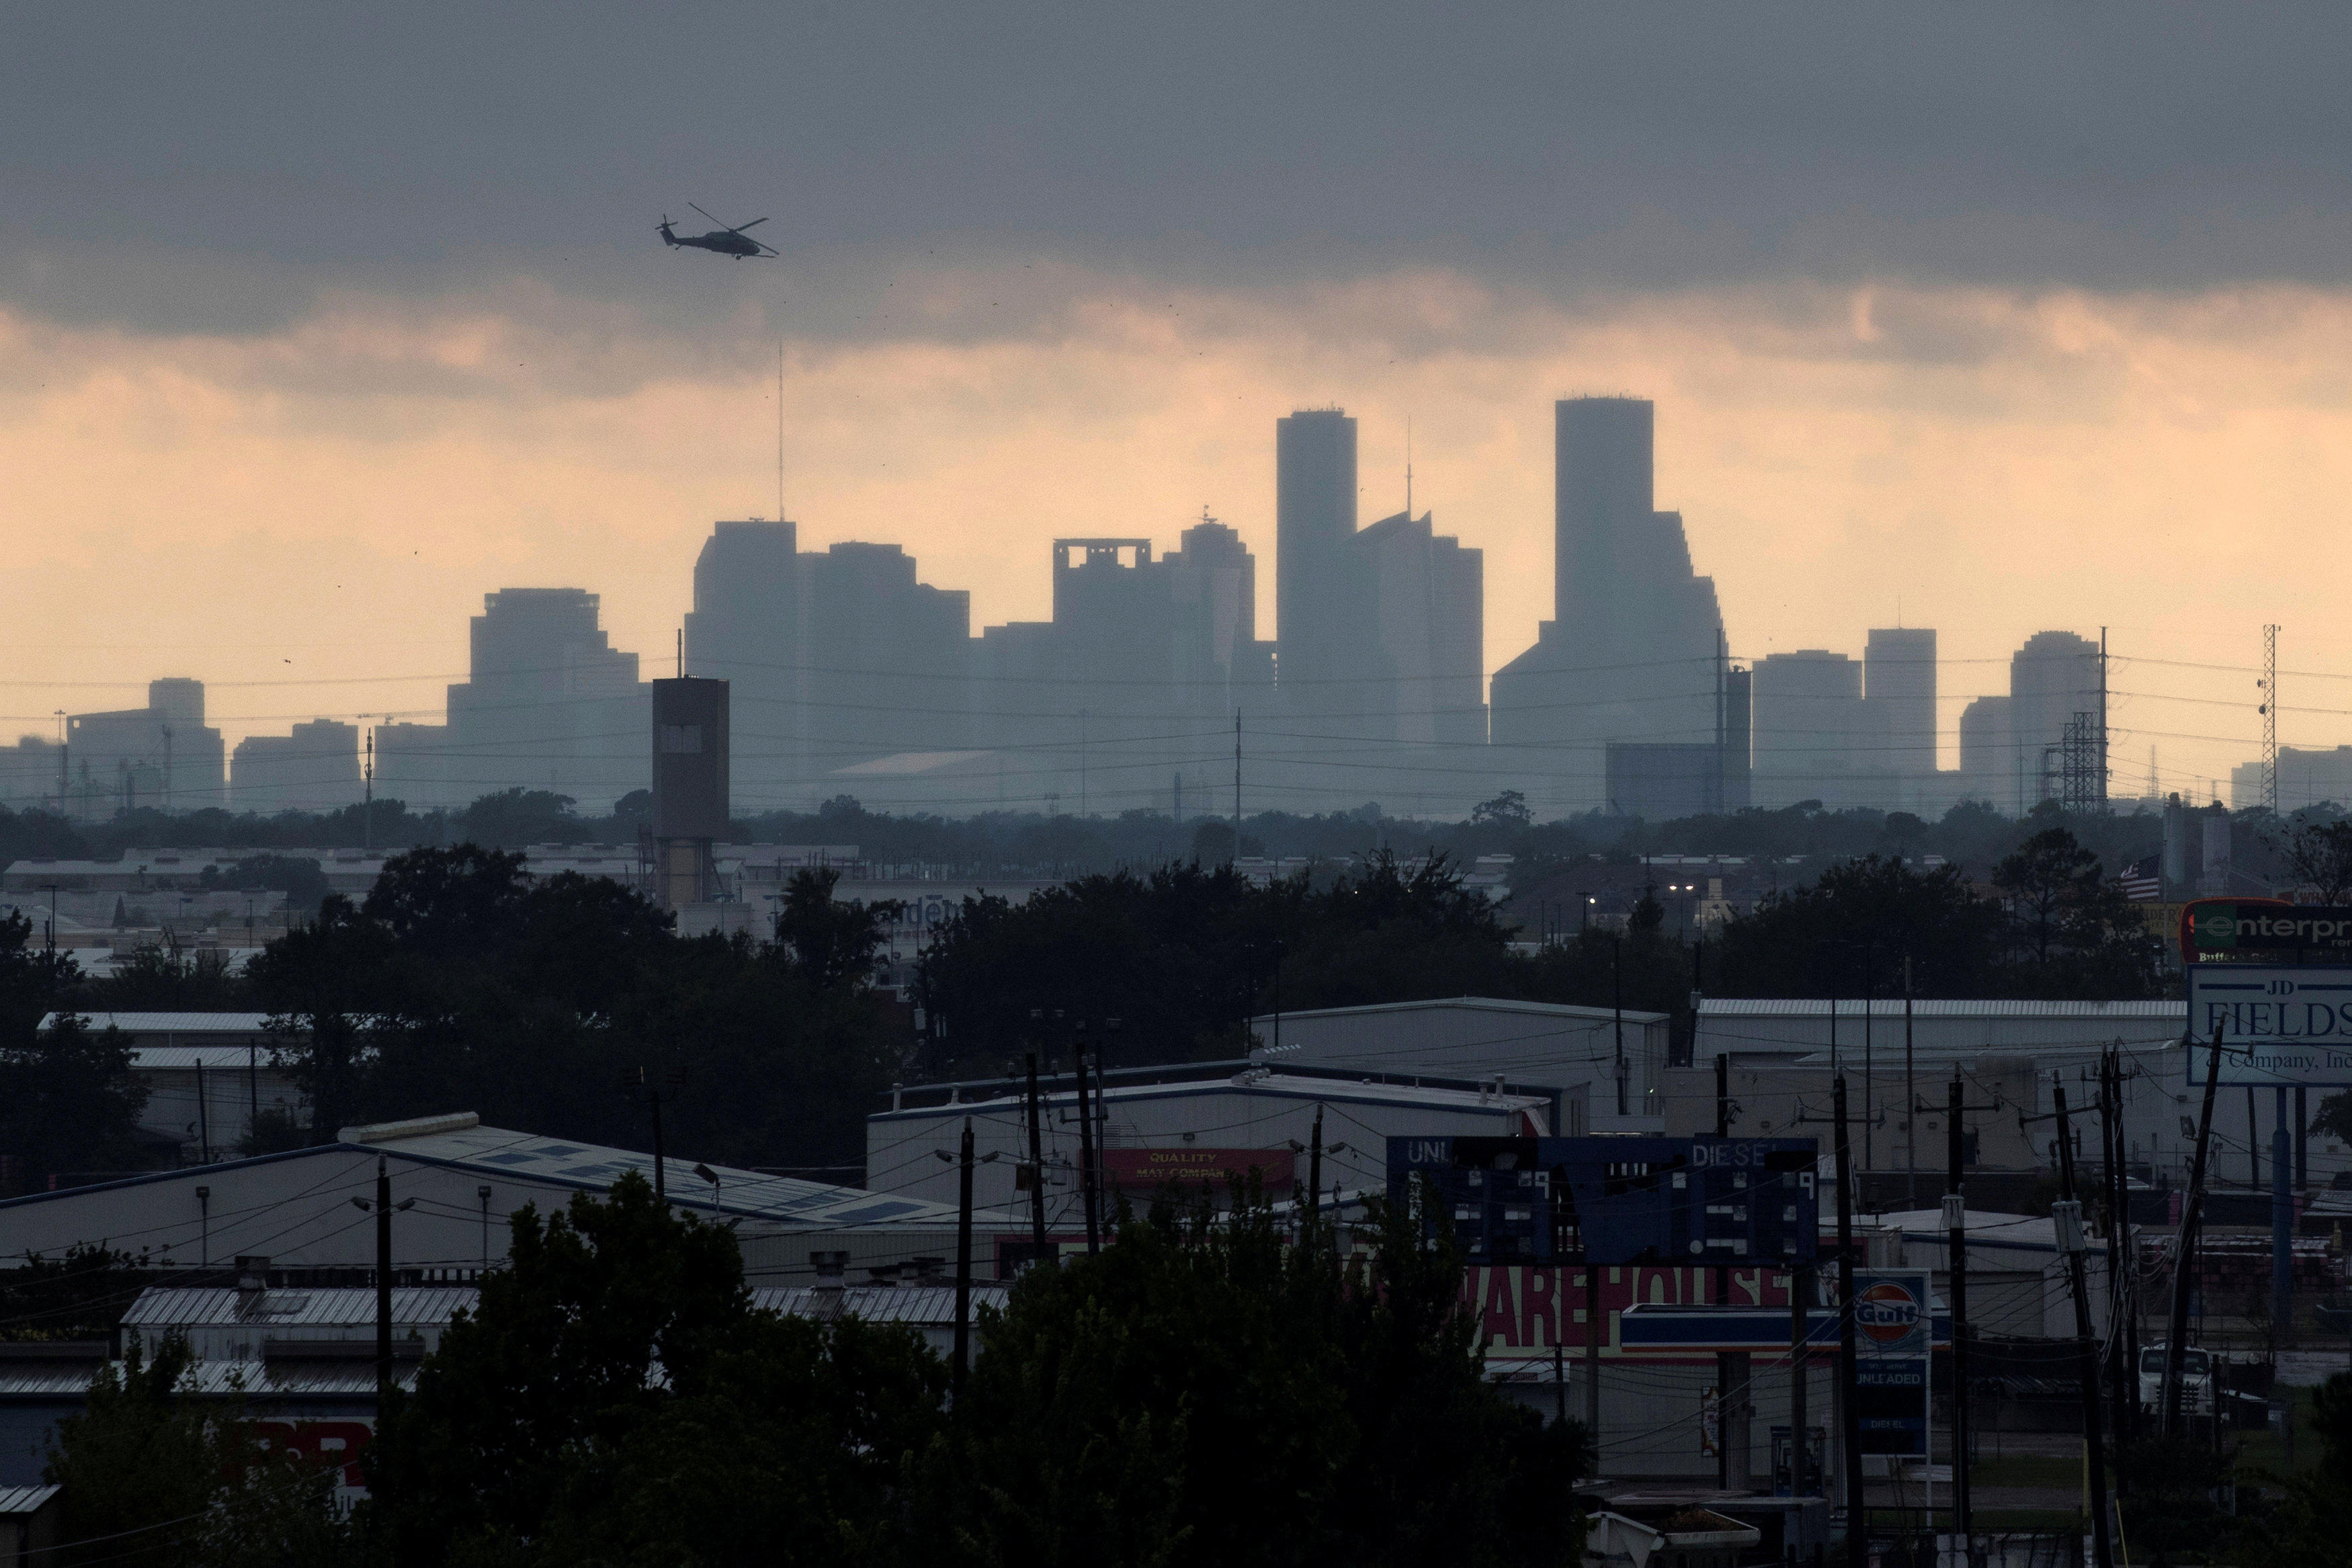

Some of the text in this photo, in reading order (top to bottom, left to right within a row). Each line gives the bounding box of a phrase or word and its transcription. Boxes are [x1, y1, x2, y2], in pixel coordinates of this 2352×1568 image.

[2267, 980, 2294, 995] JD
[2204, 1002, 2352, 1036] FIELDS
[2228, 1051, 2319, 1072] Company,
[1149, 1153, 1218, 1164] QUALITY
[1136, 1168, 1226, 1178] MAT COMPAN
[1534, 1170, 1550, 1200] 9
[1799, 1171, 1814, 1201] 9
[1857, 1304, 1917, 1322] Gulf
